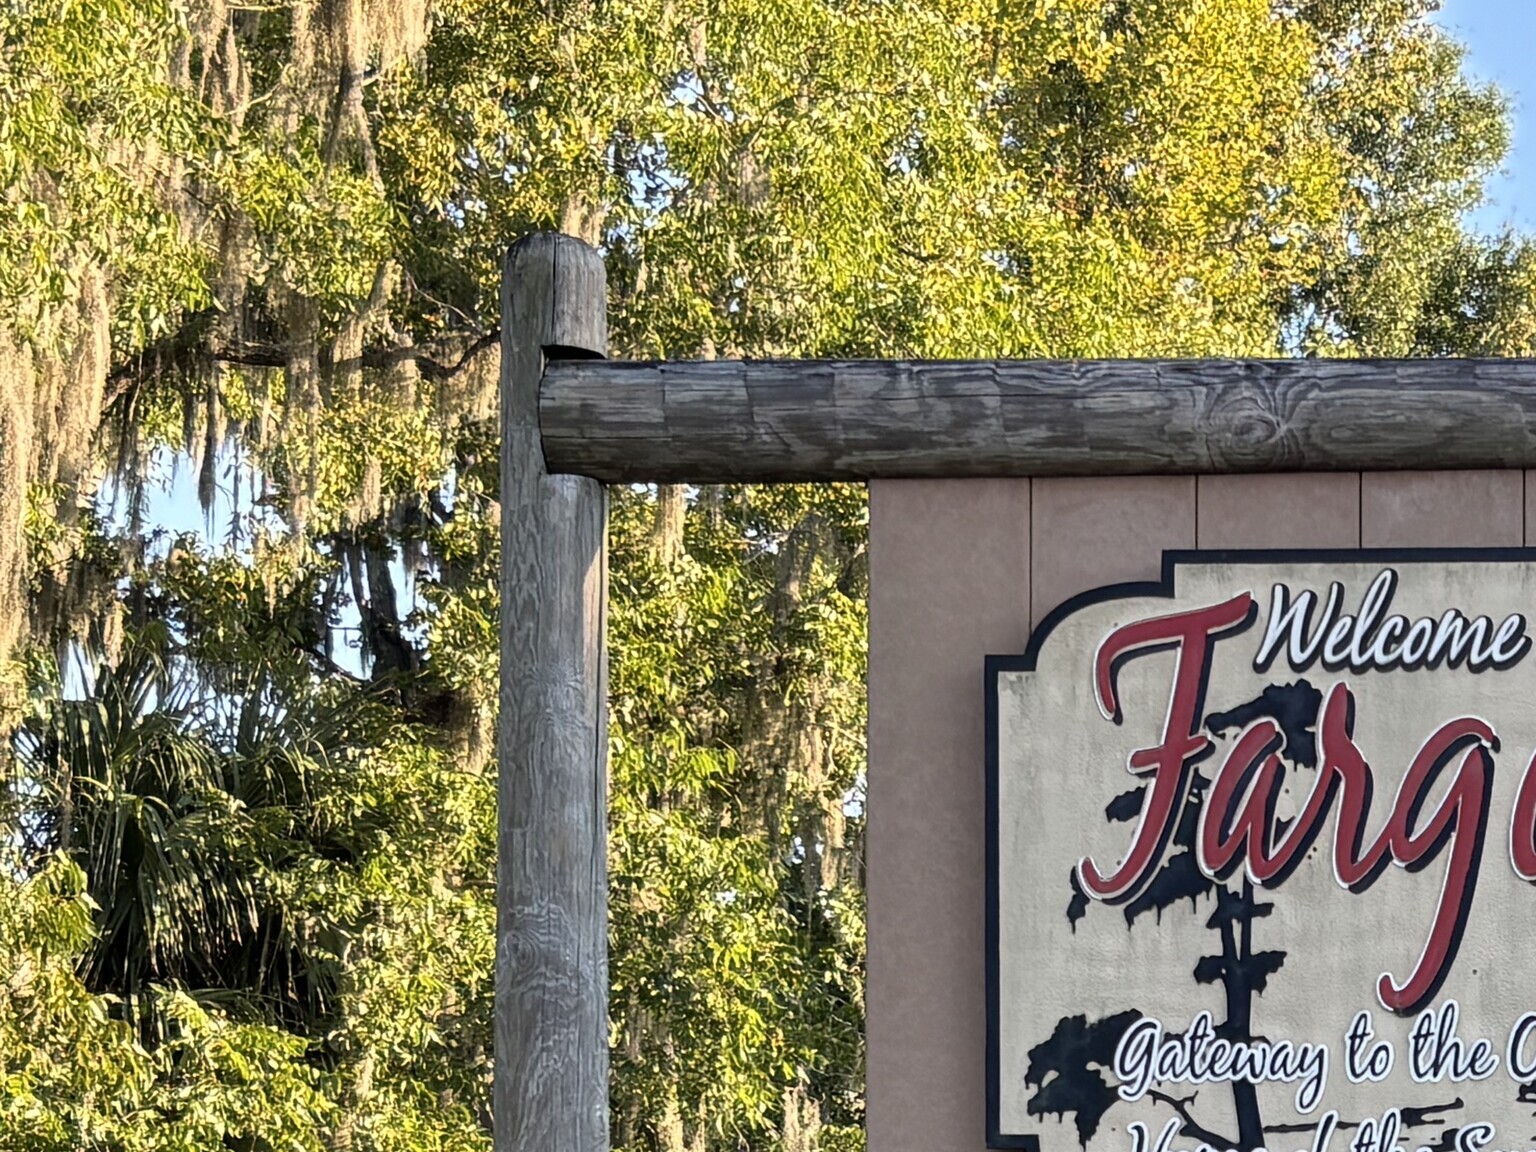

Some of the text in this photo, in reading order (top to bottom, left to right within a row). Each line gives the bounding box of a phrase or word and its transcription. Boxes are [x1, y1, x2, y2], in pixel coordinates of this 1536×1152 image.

[1252, 569, 1532, 673] Welcome
[1114, 1010, 1329, 1113] Gateway
[1346, 1010, 1394, 1083] to
[1409, 999, 1498, 1083] the
